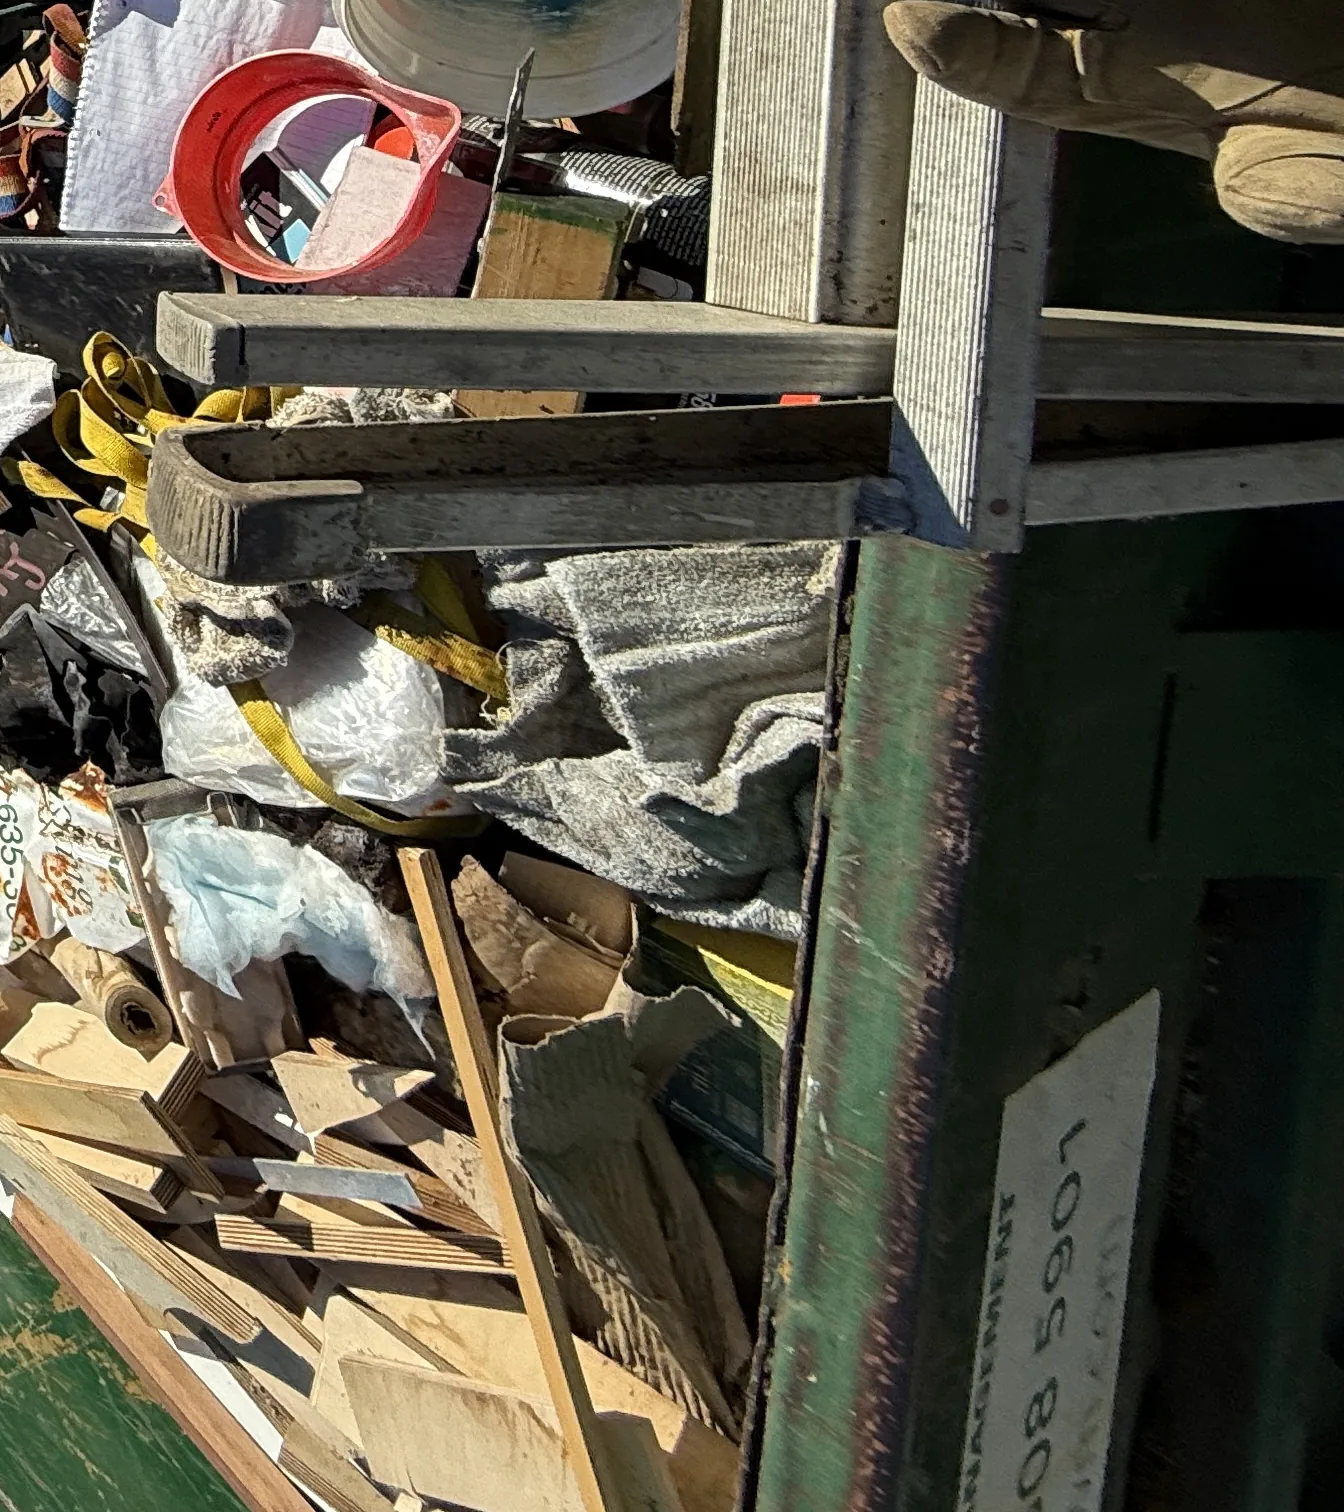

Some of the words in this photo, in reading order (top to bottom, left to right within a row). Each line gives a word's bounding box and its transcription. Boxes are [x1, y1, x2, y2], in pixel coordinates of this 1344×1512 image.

[964, 1191, 1016, 1512] NAGEMENT
[1030, 1116, 1087, 1355] 5901
[1015, 1376, 1059, 1512] 08
